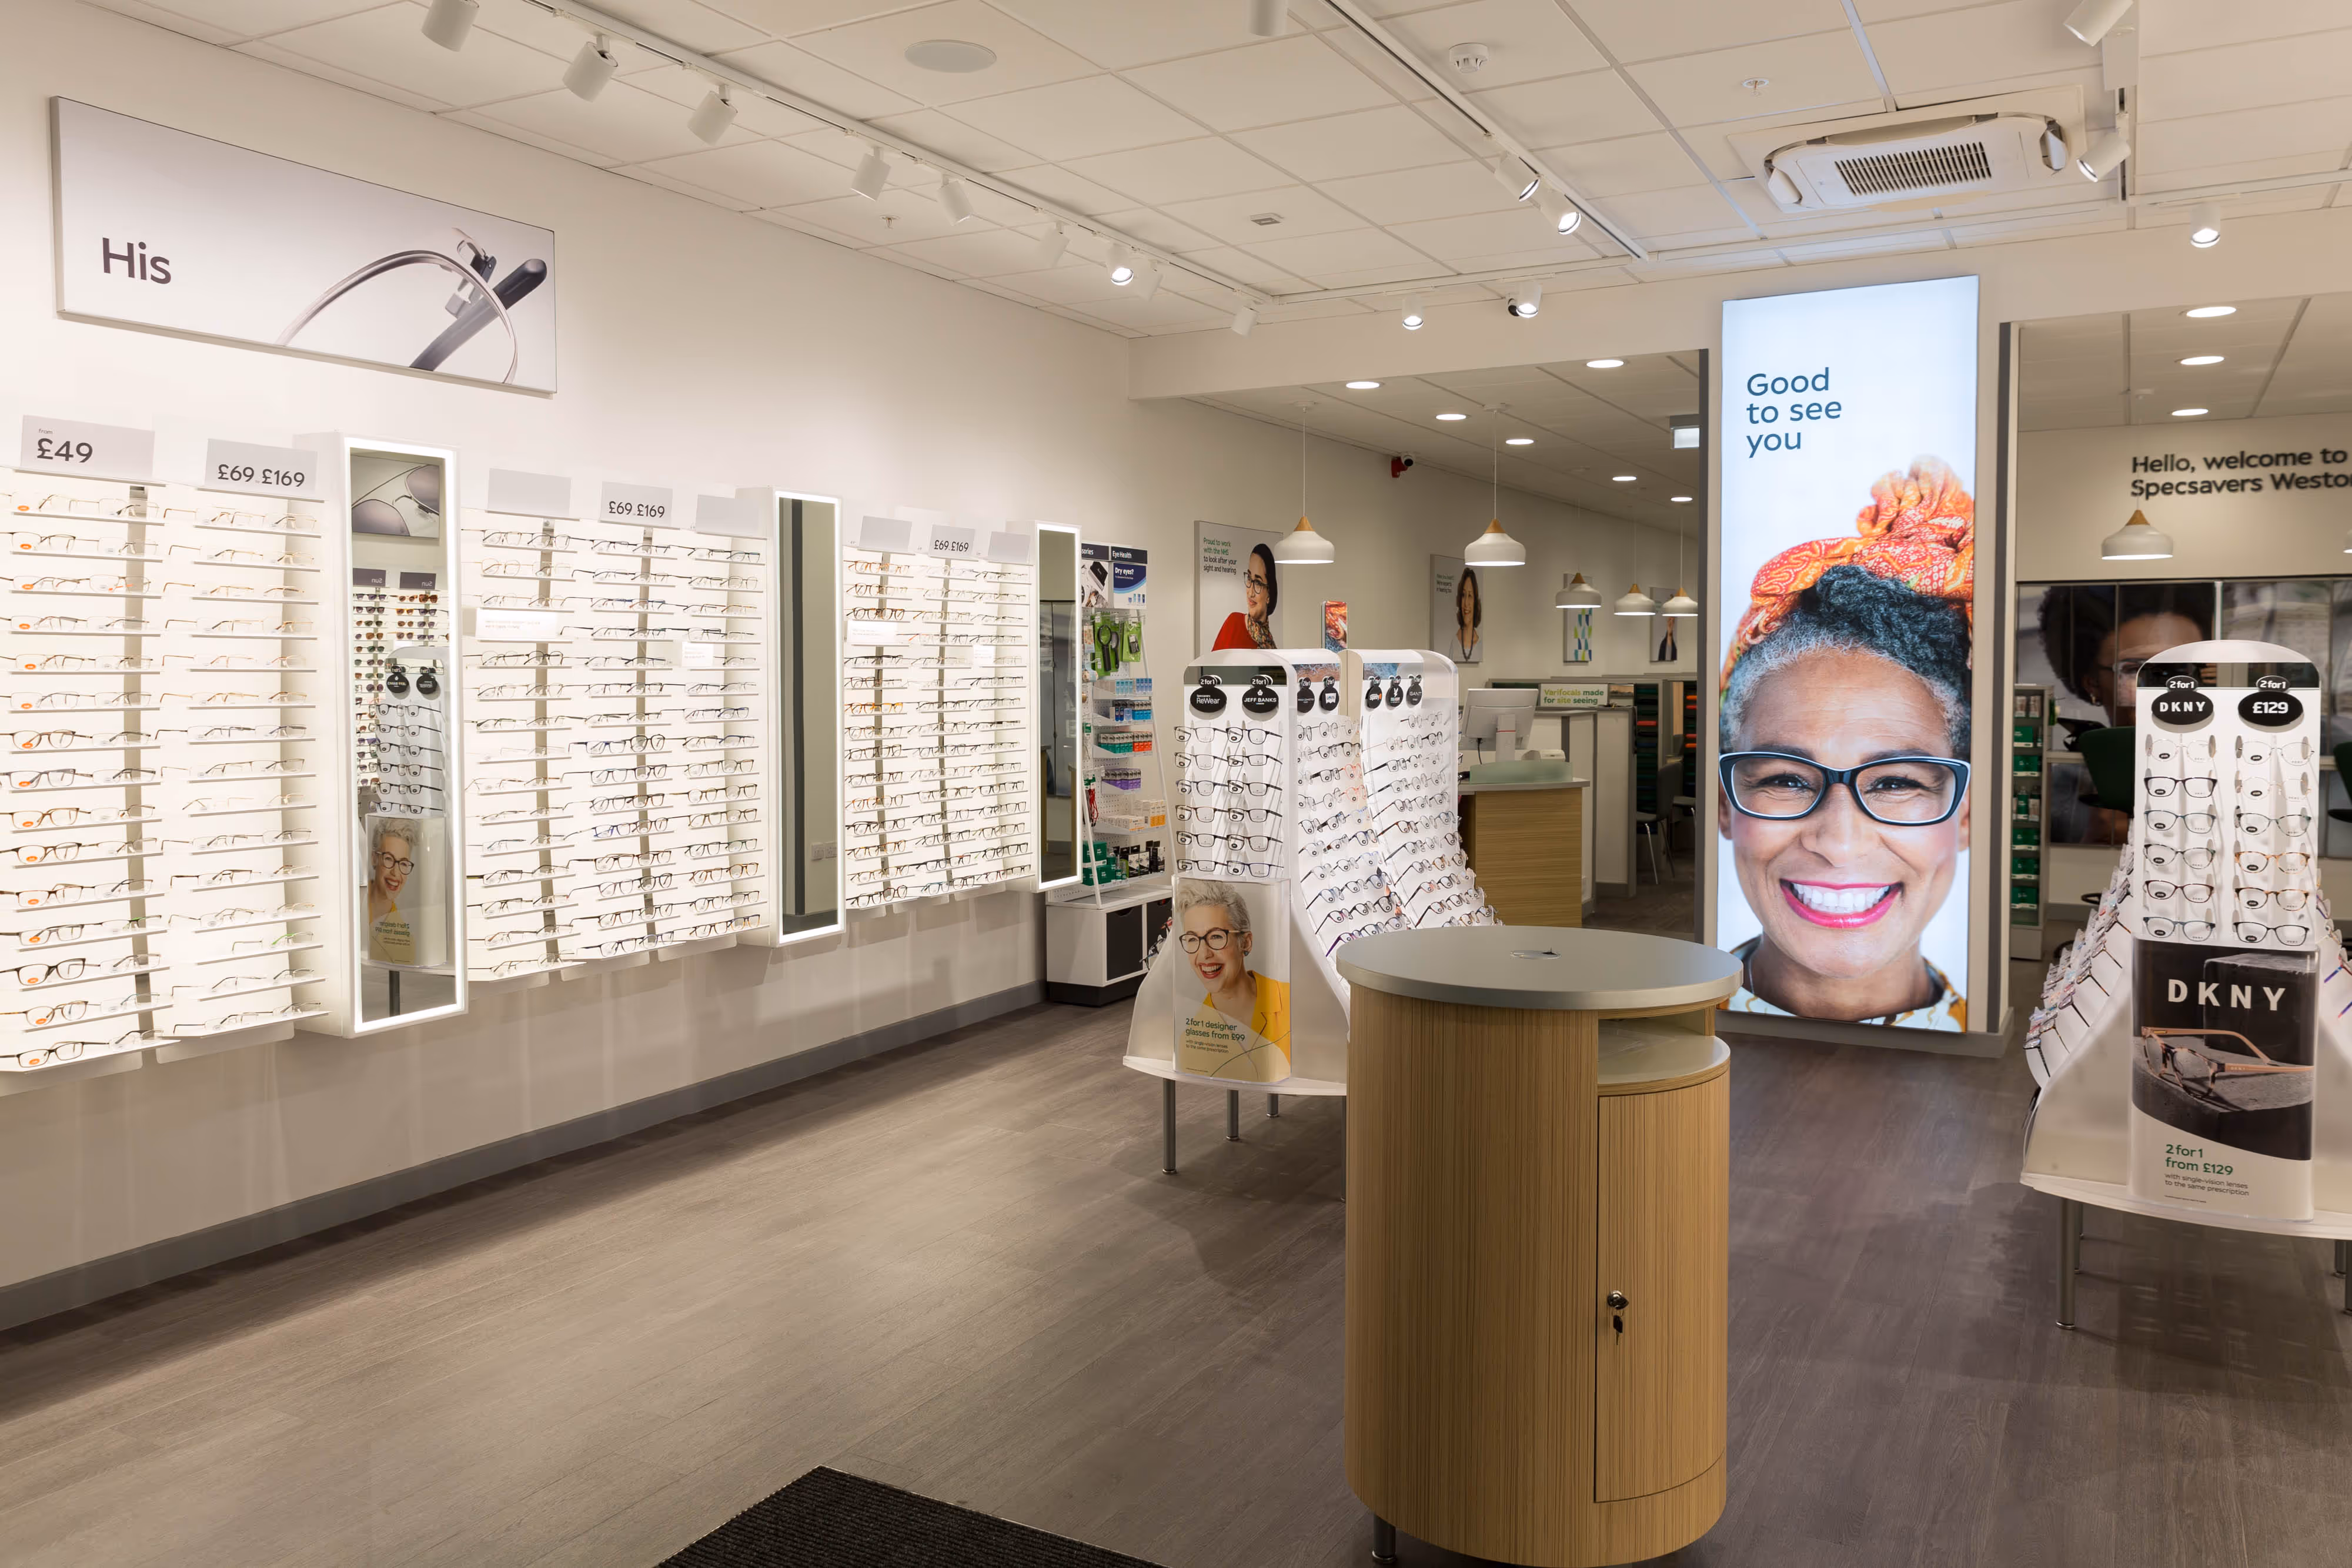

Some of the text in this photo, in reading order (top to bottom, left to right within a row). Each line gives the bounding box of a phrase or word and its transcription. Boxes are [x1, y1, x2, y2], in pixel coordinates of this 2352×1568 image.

[102, 236, 171, 285] His
[1747, 367, 1829, 396] Good
[1746, 401, 1842, 424] to see
[36, 438, 93, 463] £49
[1746, 432, 1801, 459] you
[2132, 448, 2348, 473] Hello, welcome to
[218, 464, 255, 482] £69
[262, 469, 305, 487] £169
[2130, 472, 2352, 500] Specsavers Westo
[609, 501, 665, 517] £69 £169
[934, 540, 969, 552] £69 £169
[1204, 564, 1214, 573] sight
[1222, 566, 1237, 575] hearing
[1573, 697, 1598, 705] seeing
[2159, 701, 2206, 712] DKNY
[2253, 701, 2288, 714] £129
[2167, 979, 2286, 1011] DKNY
[1190, 1018, 1200, 1027] for
[1205, 1021, 1237, 1031] designer
[1185, 1028, 1210, 1037] glasses
[1211, 1031, 1229, 1039] from
[2166, 1144, 2203, 1158] 2 for 1
[2165, 1157, 2233, 1175] from £129
[2182, 1175, 2225, 1186] single-vision
[2207, 1186, 2249, 1196] prescription
